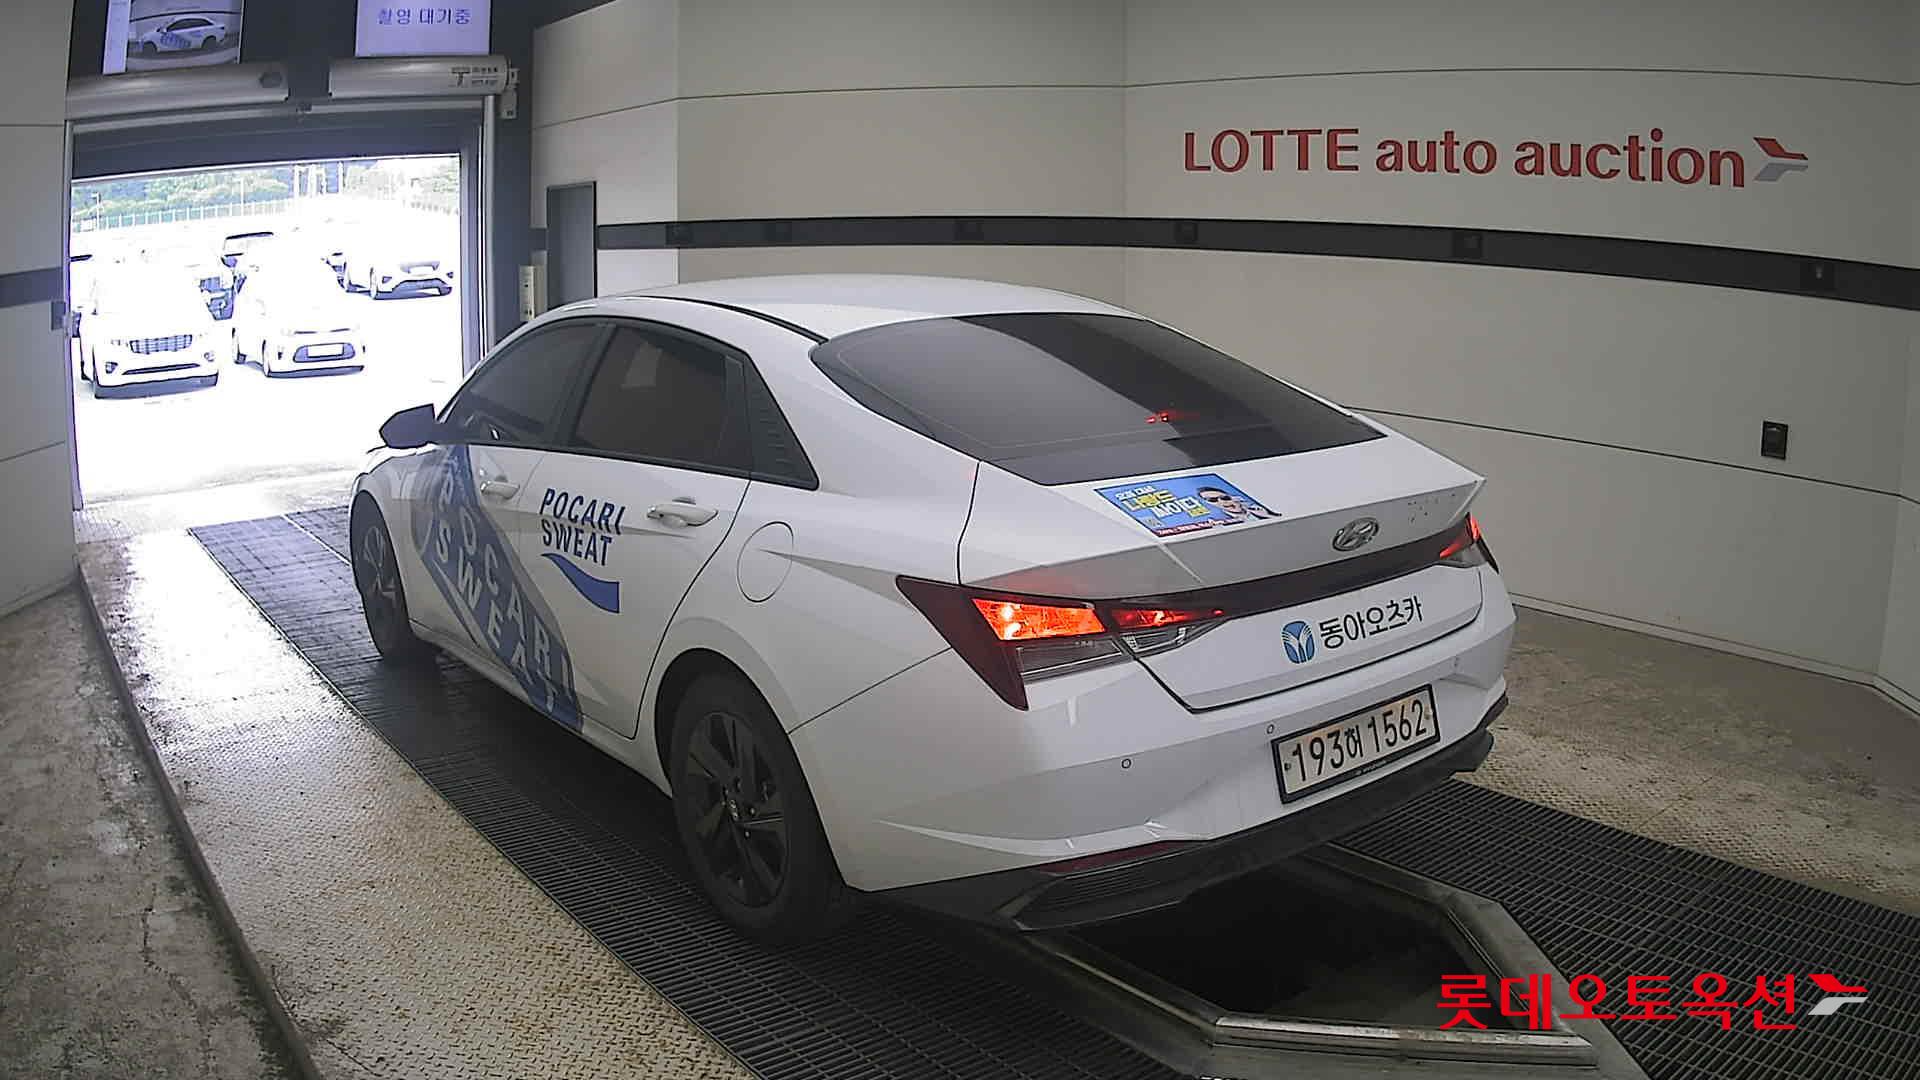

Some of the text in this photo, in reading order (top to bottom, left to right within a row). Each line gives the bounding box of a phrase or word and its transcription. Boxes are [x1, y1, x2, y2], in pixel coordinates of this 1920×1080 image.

[419, 8, 471, 25] 대기중
[1184, 128, 1746, 188] LOTTE auto auction
[539, 487, 626, 536] POCARI
[540, 518, 613, 567] SWEAT
[1319, 595, 1424, 650] 동아오츠카
[1292, 724, 1364, 783] 193허
[1368, 699, 1427, 754] 1562
